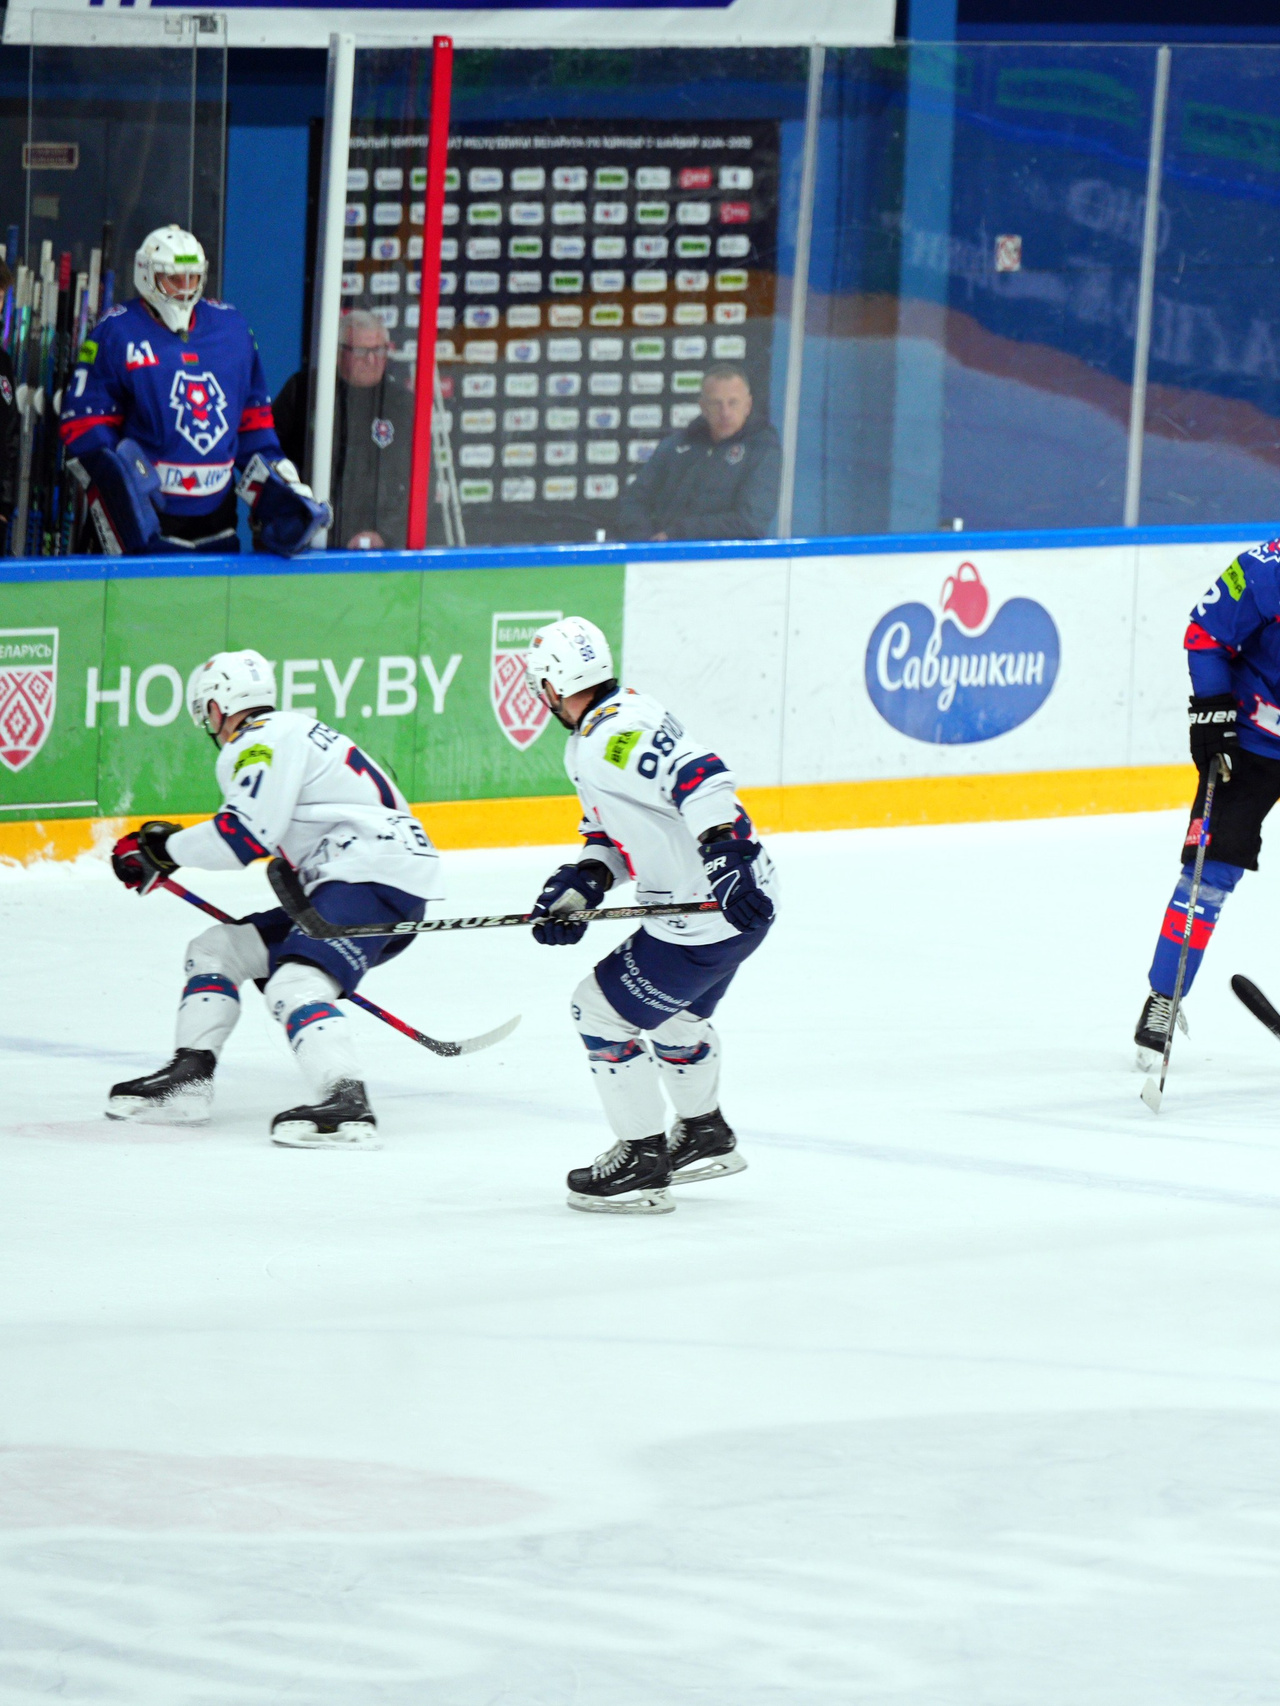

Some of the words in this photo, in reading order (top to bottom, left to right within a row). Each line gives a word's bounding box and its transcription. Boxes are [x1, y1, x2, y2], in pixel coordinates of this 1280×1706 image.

[126, 341, 155, 364] 41
[0, 643, 53, 659] ЕЛАРУСЬ
[876, 619, 1046, 712] Савушкин
[85, 654, 462, 728] HOEY.BY
[392, 914, 506, 934] SOYUZ
[623, 951, 641, 977] ООО
